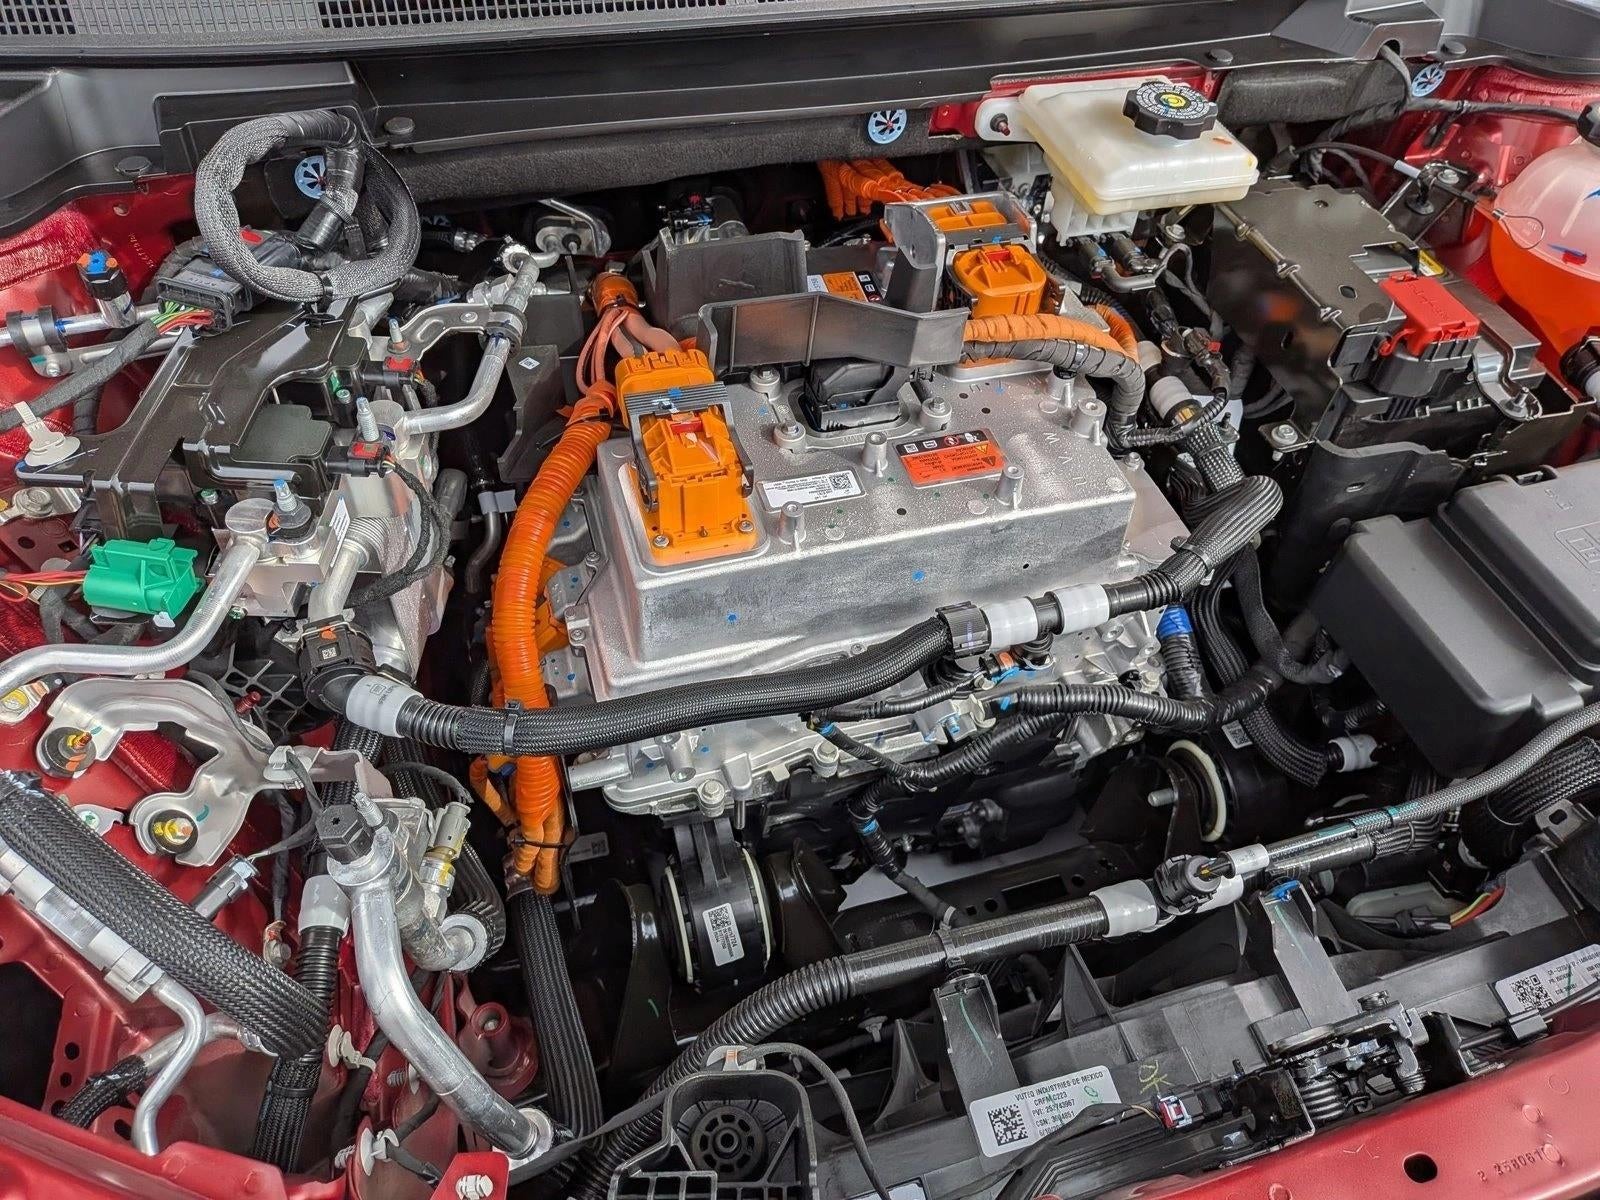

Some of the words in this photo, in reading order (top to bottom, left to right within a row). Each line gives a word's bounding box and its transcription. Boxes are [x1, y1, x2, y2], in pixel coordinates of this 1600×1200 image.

[1037, 1081, 1071, 1095] INDUSTRIES
[1072, 1077, 1081, 1086] DE
[1081, 1071, 1104, 1083] MEXICO
